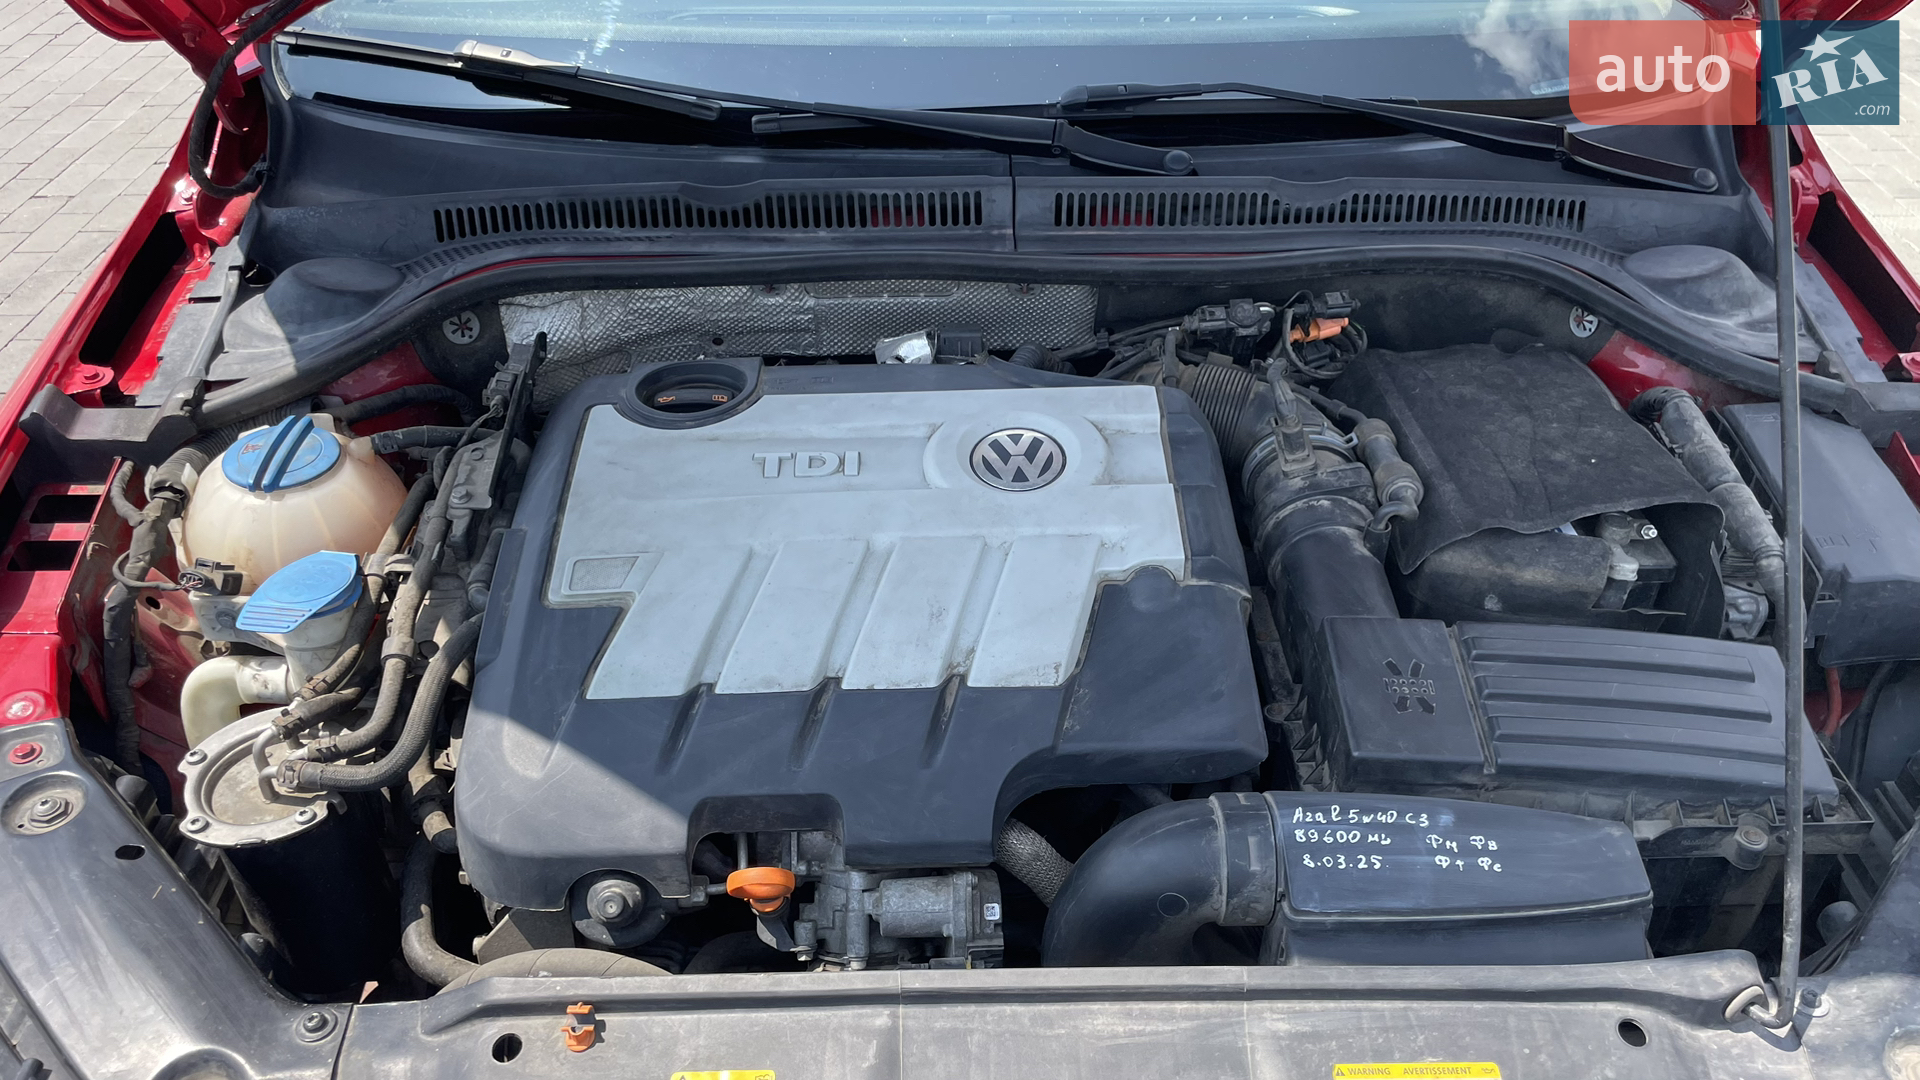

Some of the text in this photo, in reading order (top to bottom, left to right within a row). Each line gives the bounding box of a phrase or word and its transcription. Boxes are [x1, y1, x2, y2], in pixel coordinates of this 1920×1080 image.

[752, 450, 861, 478] TDI
[1294, 828, 1361, 843] 89600
[1348, 1066, 1472, 1076] WARNING AVERTISSEMENT
